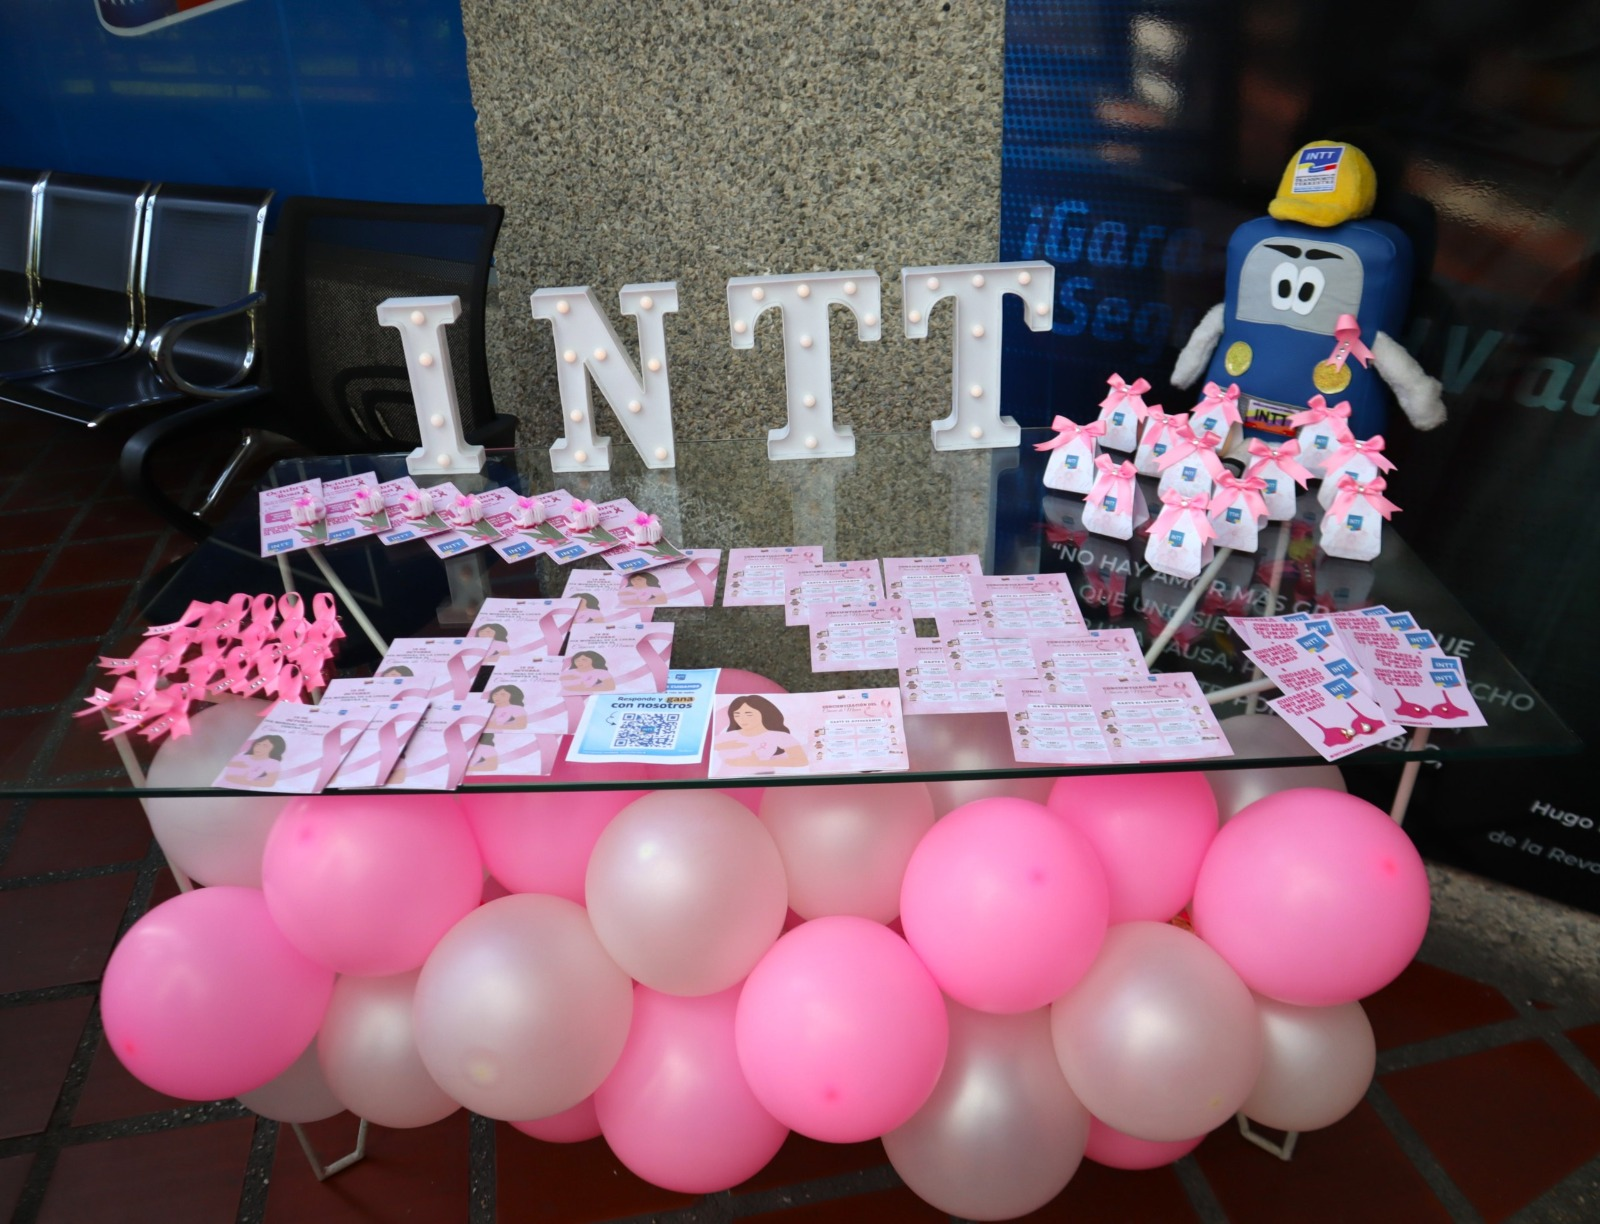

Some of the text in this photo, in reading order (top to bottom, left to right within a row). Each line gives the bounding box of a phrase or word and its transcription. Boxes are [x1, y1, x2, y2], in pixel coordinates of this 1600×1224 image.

[1305, 151, 1336, 161] INTT
[1254, 408, 1287, 426] INTT
[443, 541, 461, 550] INTT
[508, 545, 527, 554] INTT
[560, 548, 579, 556] INTT
[623, 560, 642, 568] INTT
[1100, 555, 1149, 578] HAY
[1303, 638, 1319, 648] INTT
[1331, 663, 1348, 674] INTT
[1330, 684, 1348, 694] INTT
[666, 695, 695, 704] gana
[1530, 800, 1594, 829] Hugo
[1488, 830, 1517, 850] de
[1521, 839, 1544, 857] la
